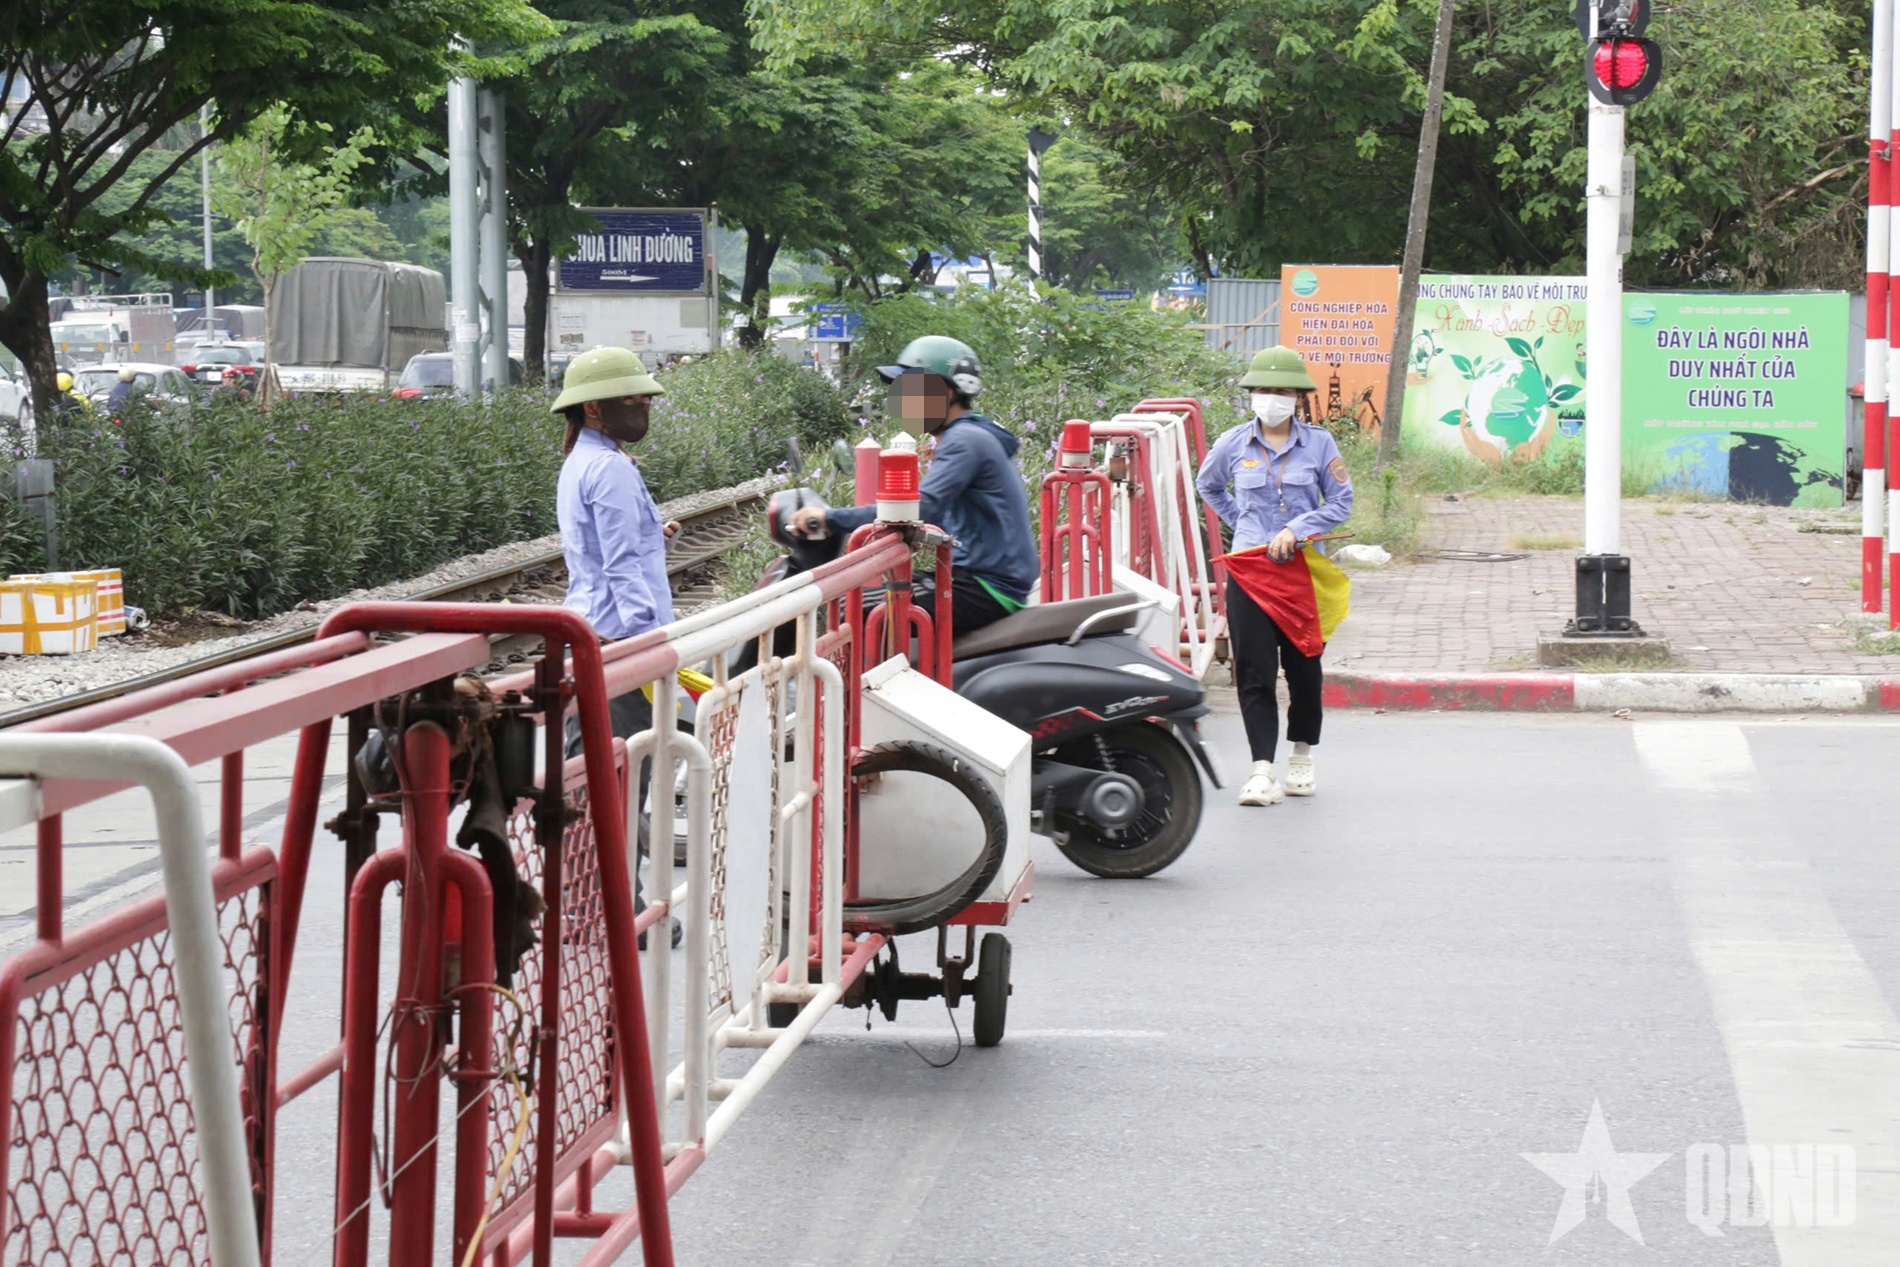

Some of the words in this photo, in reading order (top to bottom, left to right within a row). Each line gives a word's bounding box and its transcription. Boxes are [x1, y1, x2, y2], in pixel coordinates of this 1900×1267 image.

[610, 235, 641, 262] LINH
[1439, 284, 1474, 298] CHUNG
[1478, 284, 1498, 299] TAY
[1502, 280, 1523, 299] BẢO
[1527, 282, 1539, 302] VỆ
[1543, 282, 1563, 299] MÔI
[1290, 301, 1319, 312] CÔNG
[1323, 302, 1362, 314] NGHIỆP
[1303, 318, 1327, 330] HIỆN
[1331, 319, 1348, 331] ĐẠI
[1433, 304, 1482, 333] Xanh
[1492, 303, 1535, 337] Sạch
[1545, 304, 1585, 338] Đẹp
[1297, 333, 1322, 345] PHẢI
[1326, 336, 1336, 346] ĐI
[1340, 334, 1357, 346] ĐÔI
[1362, 333, 1378, 346] VỚI
[1657, 326, 1693, 348] ĐÂY
[1698, 327, 1718, 348] LÀ
[1724, 327, 1766, 349] NGÔI
[1772, 326, 1809, 348] NHÀ
[1325, 350, 1345, 362] MÔI
[1669, 360, 1704, 378] DUY
[1710, 353, 1757, 378] NHẤT
[1762, 355, 1795, 378] CỦA
[1689, 385, 1746, 407] CHÚNG
[1752, 390, 1774, 407] TA
